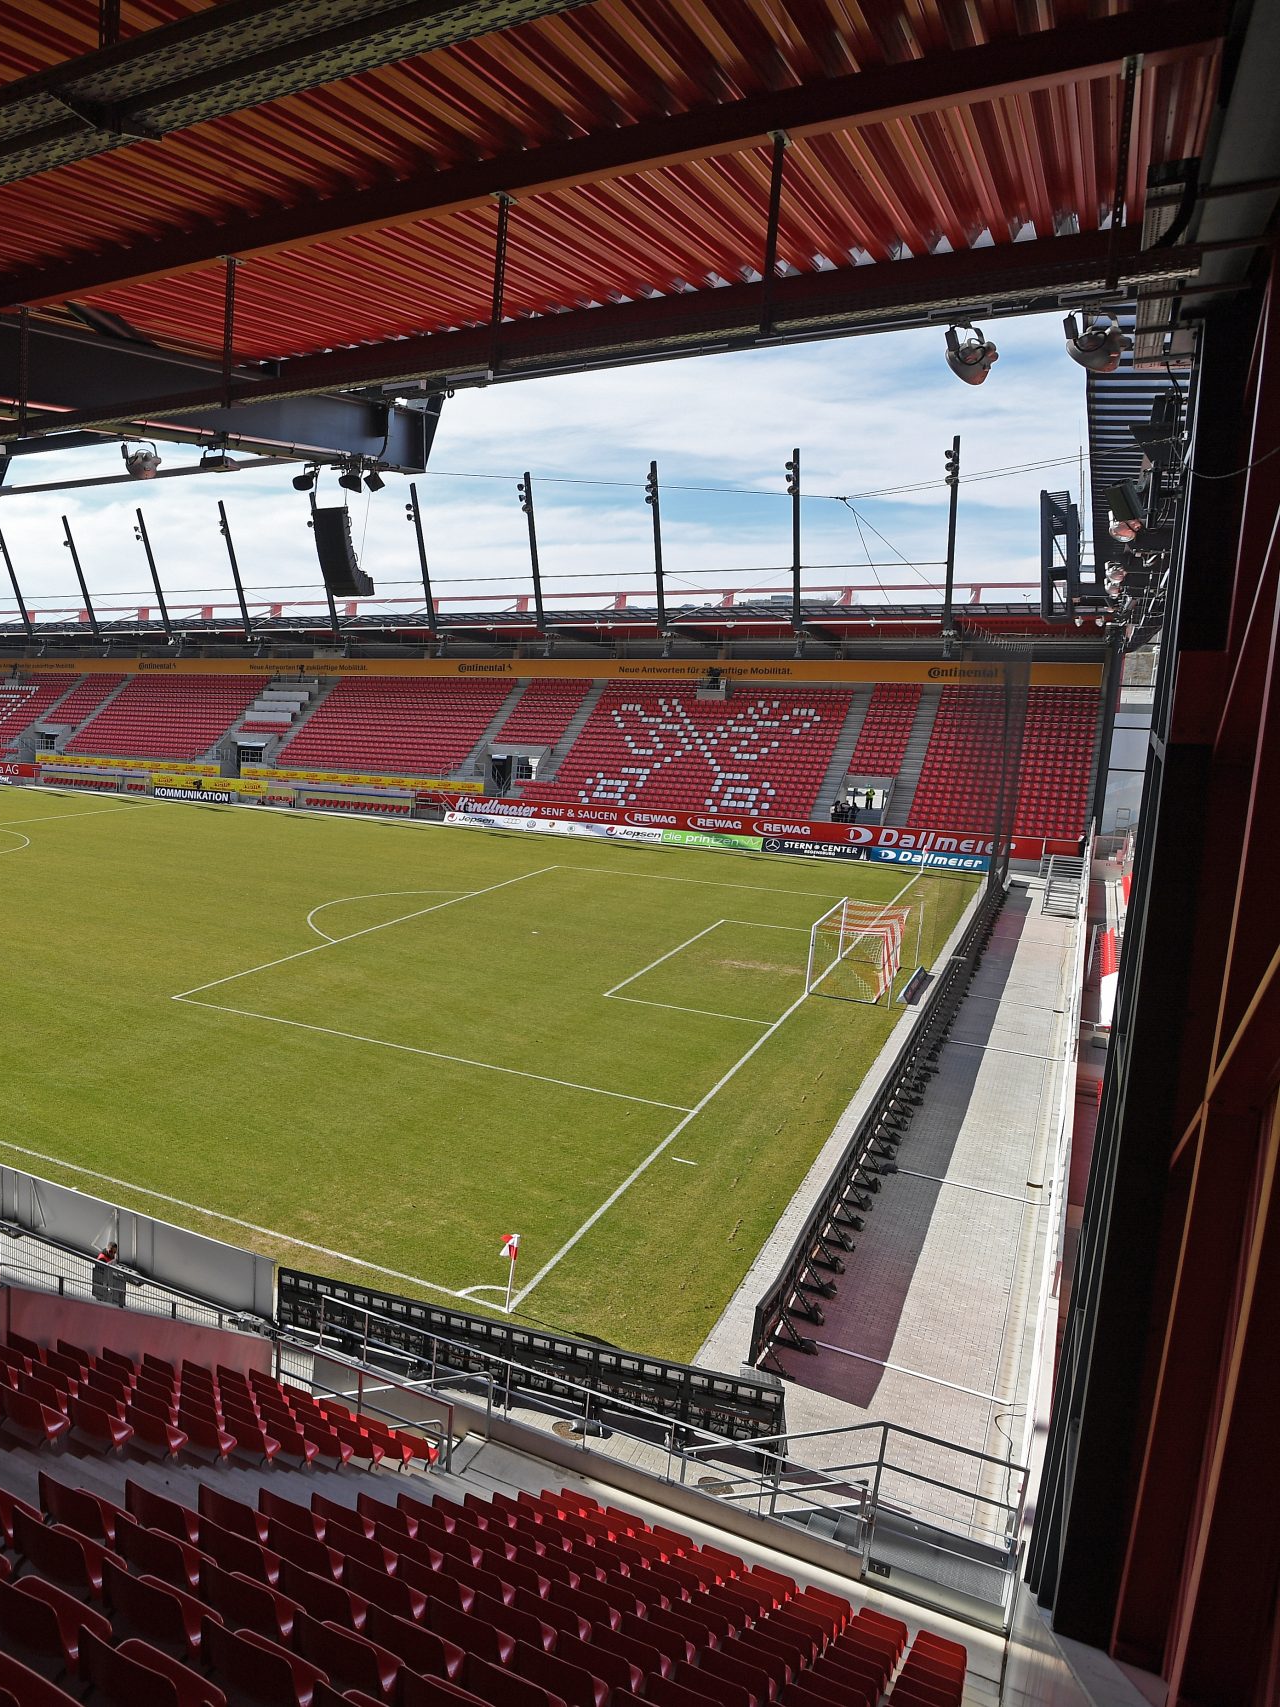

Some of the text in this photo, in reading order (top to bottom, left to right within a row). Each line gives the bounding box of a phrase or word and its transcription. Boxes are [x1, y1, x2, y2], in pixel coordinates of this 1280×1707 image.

[138, 661, 171, 670] Continental
[458, 663, 506, 673] Continental
[641, 666, 686, 674] Antworten
[687, 666, 699, 674] für
[750, 667, 793, 675] Mobilität.
[927, 667, 999, 679] Continental
[5, 764, 19, 775] AG
[154, 787, 229, 802] KOMMUNIKATION
[455, 796, 618, 821] Händlmaier SENF & SAUCEN
[458, 815, 495, 825] Jepsen
[633, 813, 677, 825] REWAG
[696, 817, 742, 830] REWAG
[618, 828, 662, 839] Jepsen
[763, 822, 811, 835] REWAG
[663, 832, 739, 846] die printzen
[877, 828, 1016, 856] Dallmeier
[783, 841, 858, 854] STERN CENTER
[898, 851, 983, 868] Dallmeier
